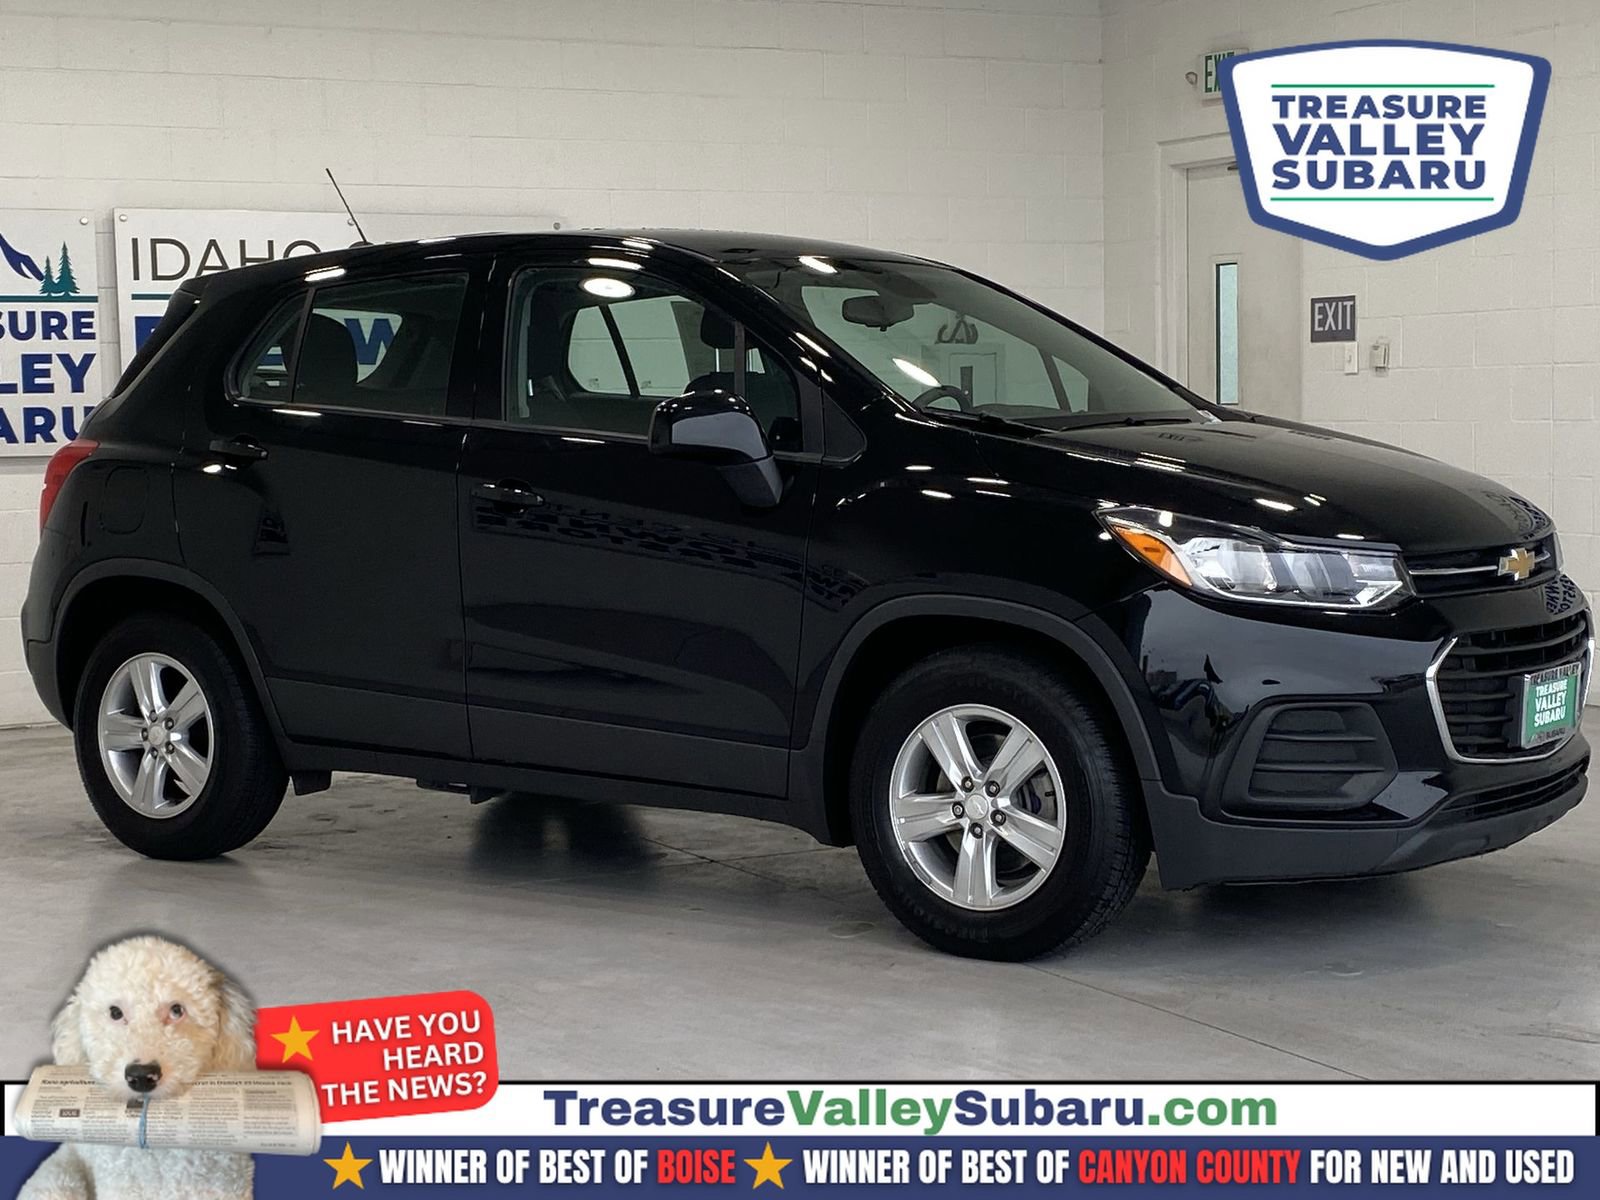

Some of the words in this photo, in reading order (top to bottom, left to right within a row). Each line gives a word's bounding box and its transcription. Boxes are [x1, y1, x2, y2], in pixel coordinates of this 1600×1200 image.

[1205, 51, 1234, 93] EX
[0, 310, 97, 341] URE
[1314, 301, 1354, 332] EXIT
[0, 353, 97, 394] EY
[1535, 690, 1567, 712] VALLEY
[1536, 679, 1568, 697] TREASURE
[1533, 705, 1566, 727] SUBARU
